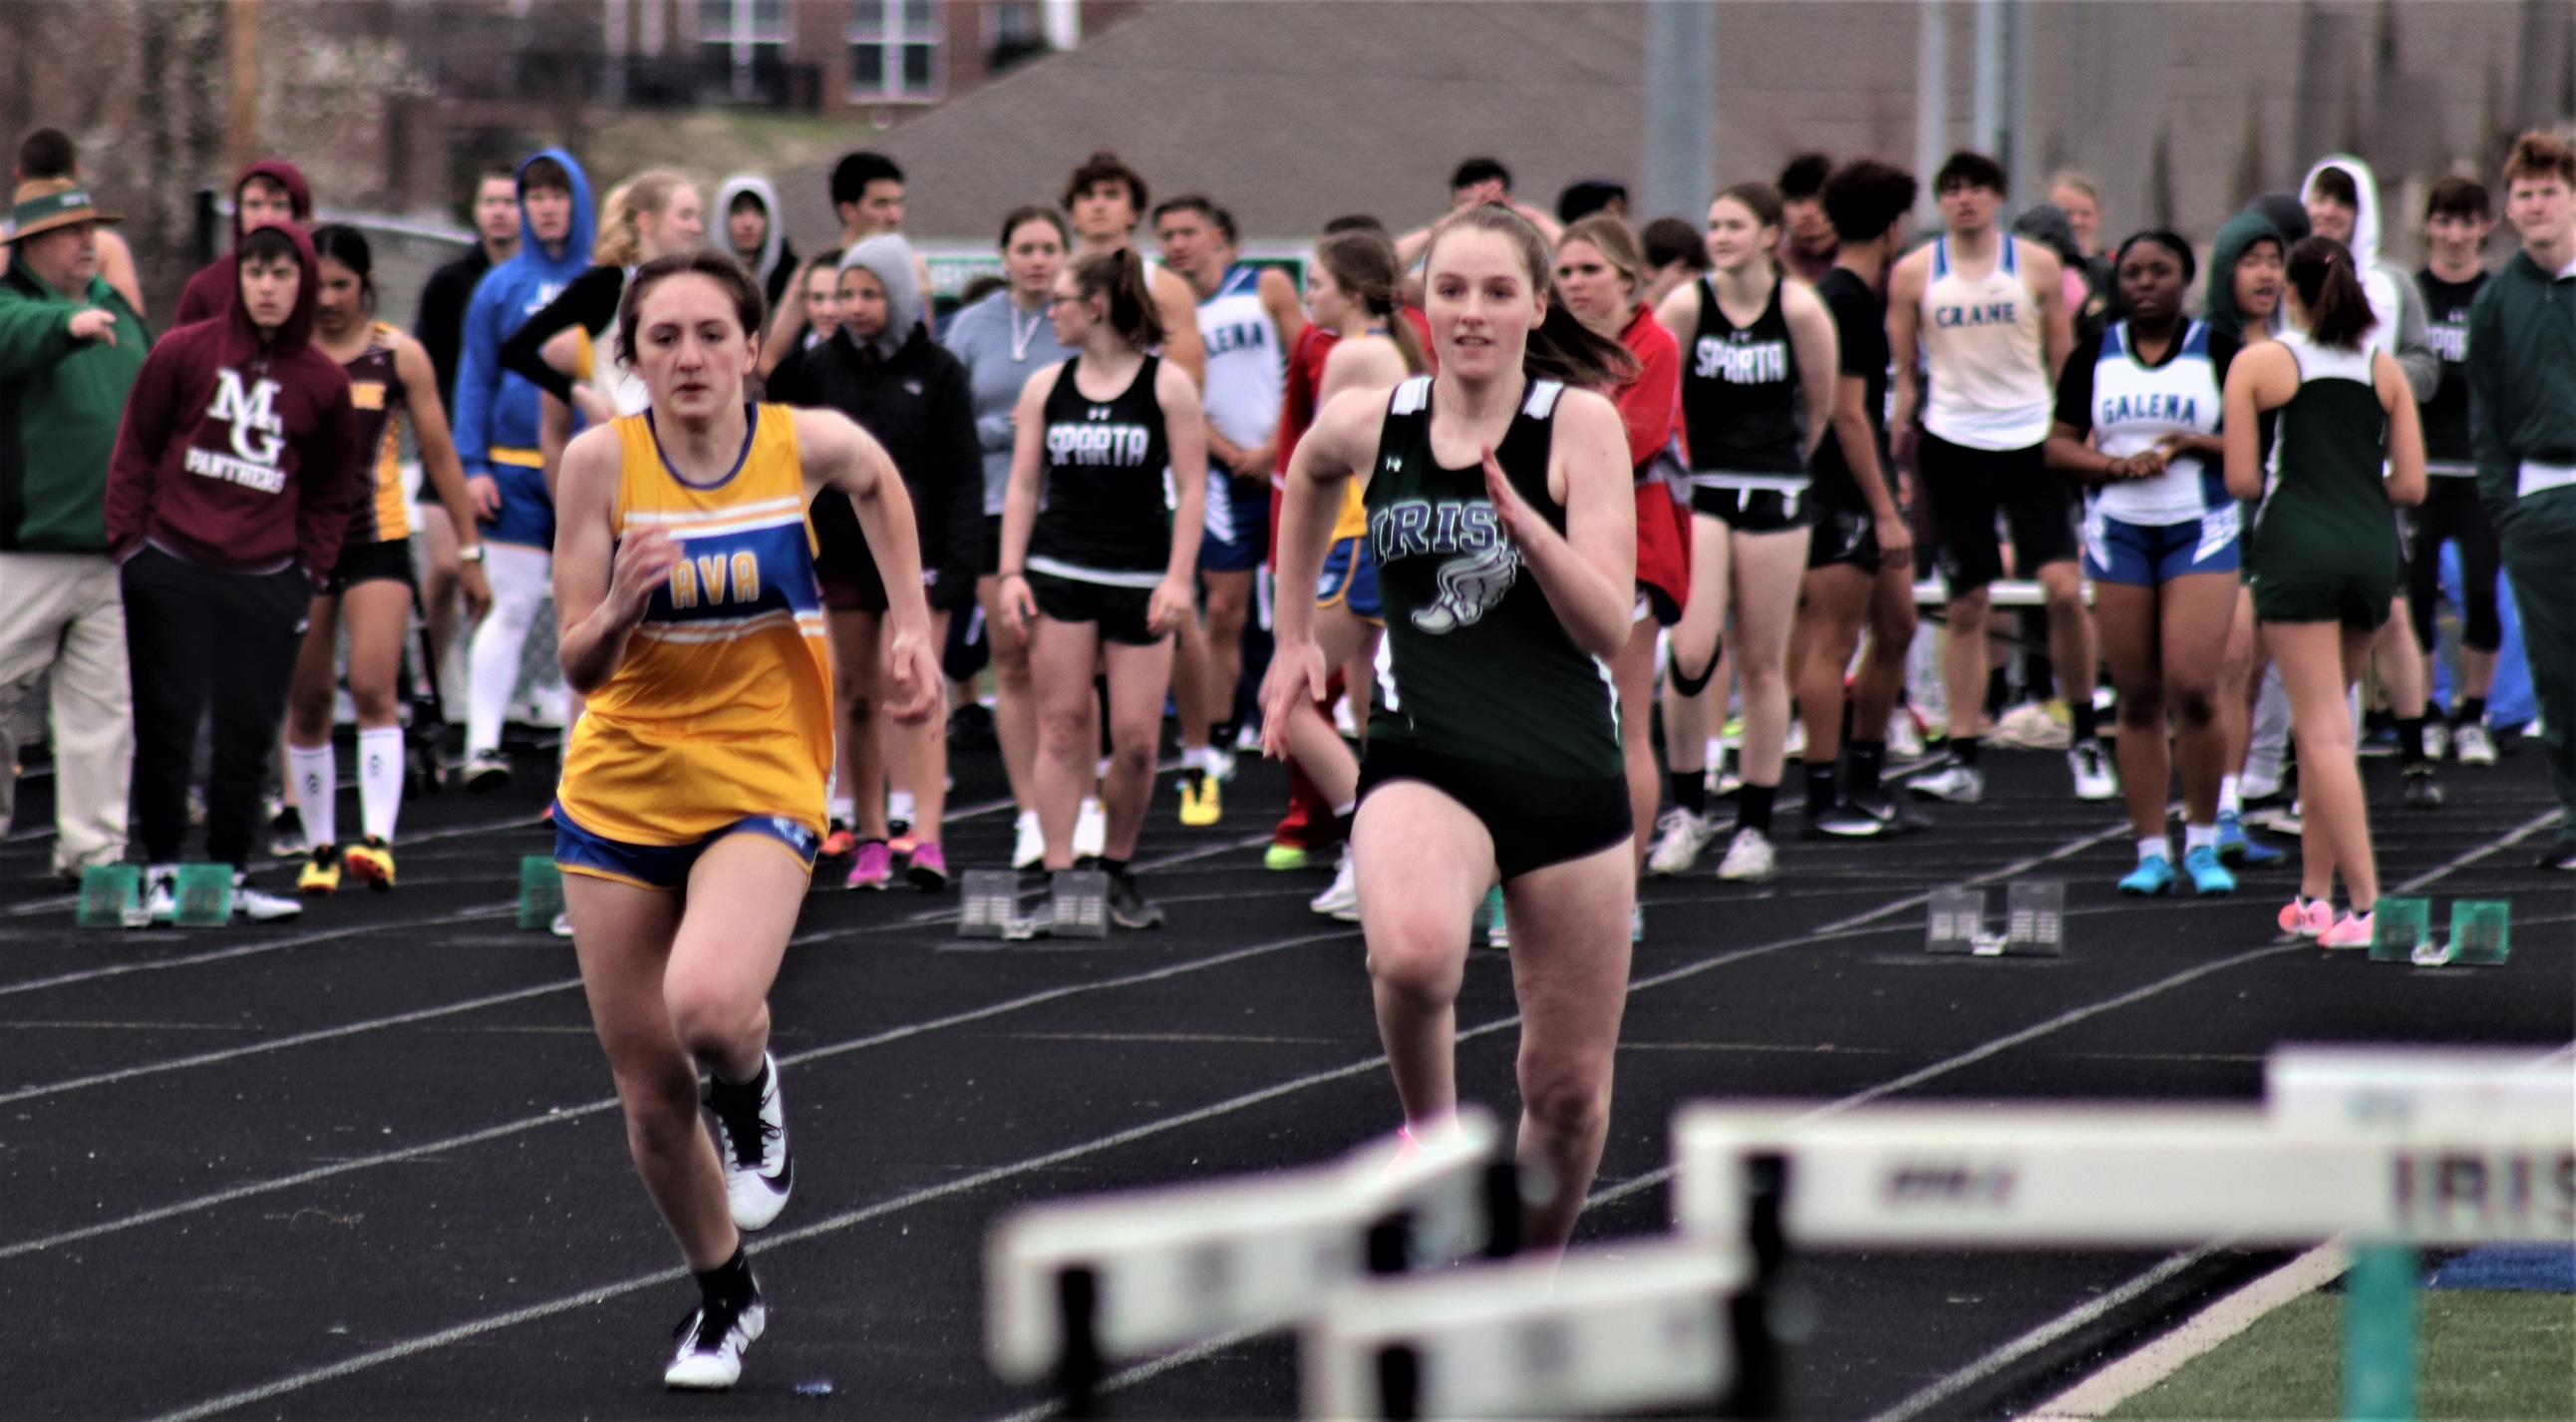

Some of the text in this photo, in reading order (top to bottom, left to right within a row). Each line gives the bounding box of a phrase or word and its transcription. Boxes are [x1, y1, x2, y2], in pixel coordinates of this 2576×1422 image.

[1935, 302, 2016, 328] CRANE
[1695, 336, 1785, 384] SPARTA
[2101, 393, 2197, 426] GALENA
[1048, 423, 1149, 466] SPARTA
[184, 447, 285, 495] PANTHERS
[1372, 499, 1525, 570] IRIS
[670, 550, 760, 609] AVA
